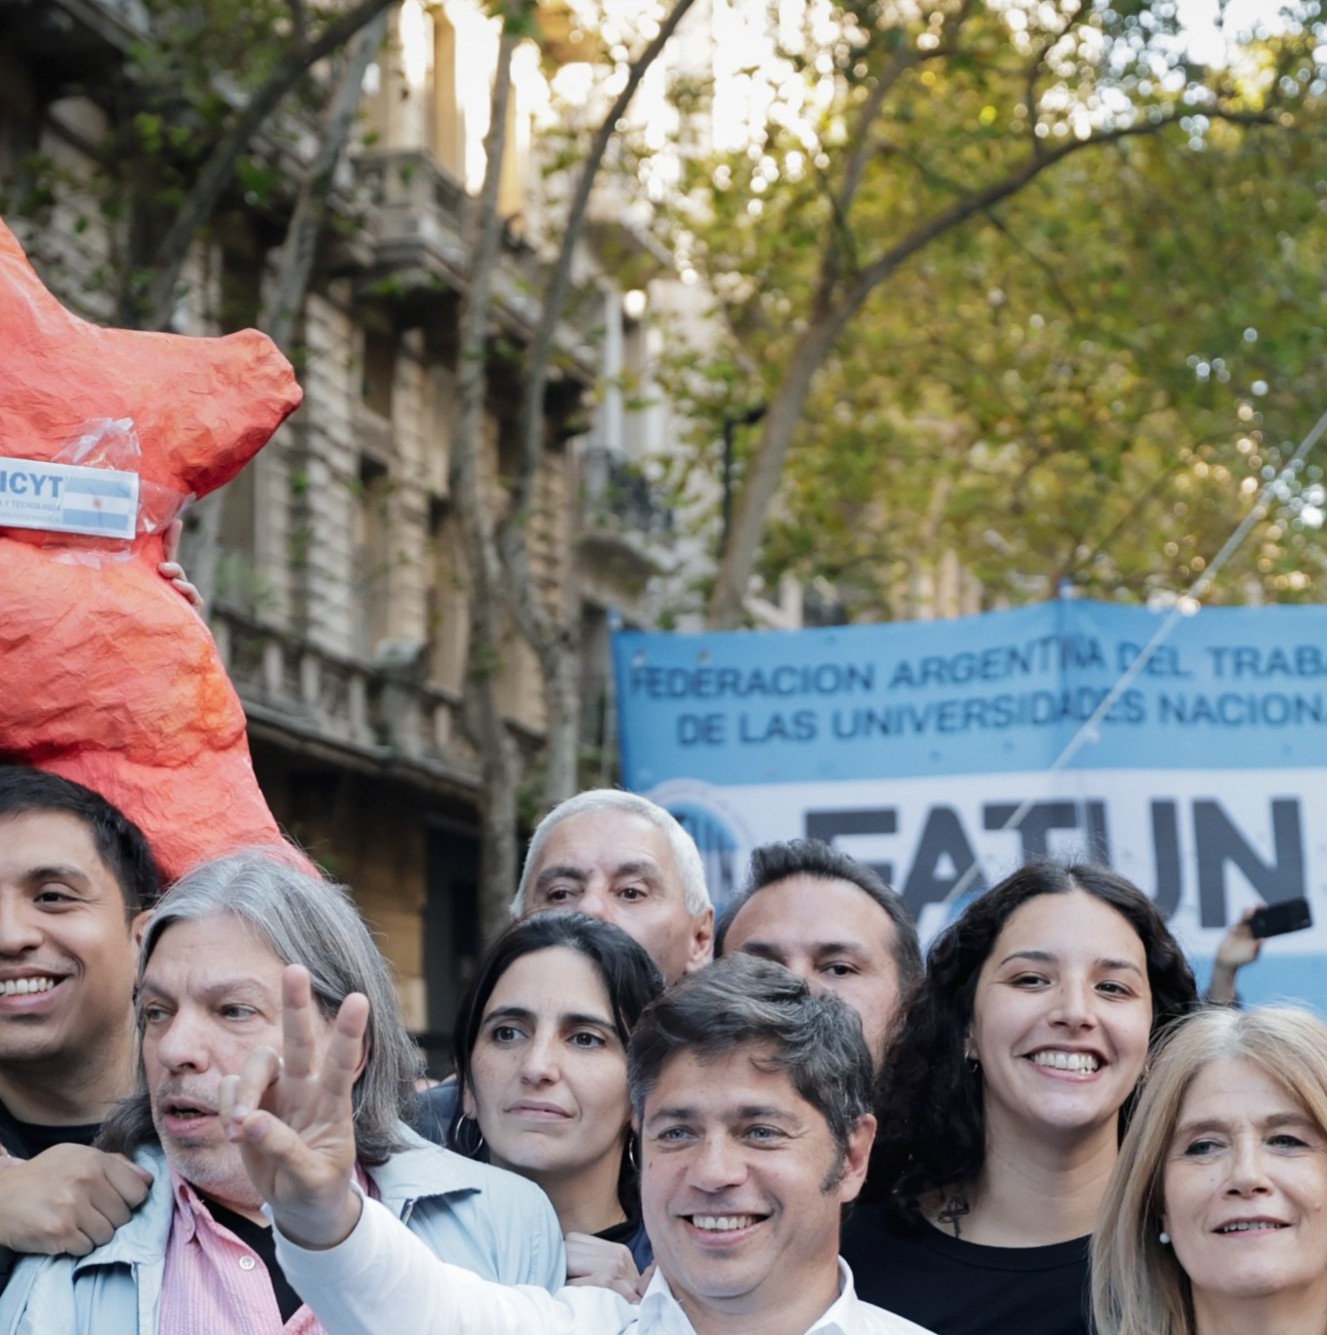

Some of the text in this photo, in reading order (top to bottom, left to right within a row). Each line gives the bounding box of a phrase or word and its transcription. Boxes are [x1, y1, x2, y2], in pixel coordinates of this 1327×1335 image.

[630, 662, 873, 699] FEDERACION
[1117, 642, 1191, 677] DEL
[676, 713, 726, 747] DE
[739, 709, 818, 745] LAS
[832, 687, 1145, 741] UNIVERSIDADES
